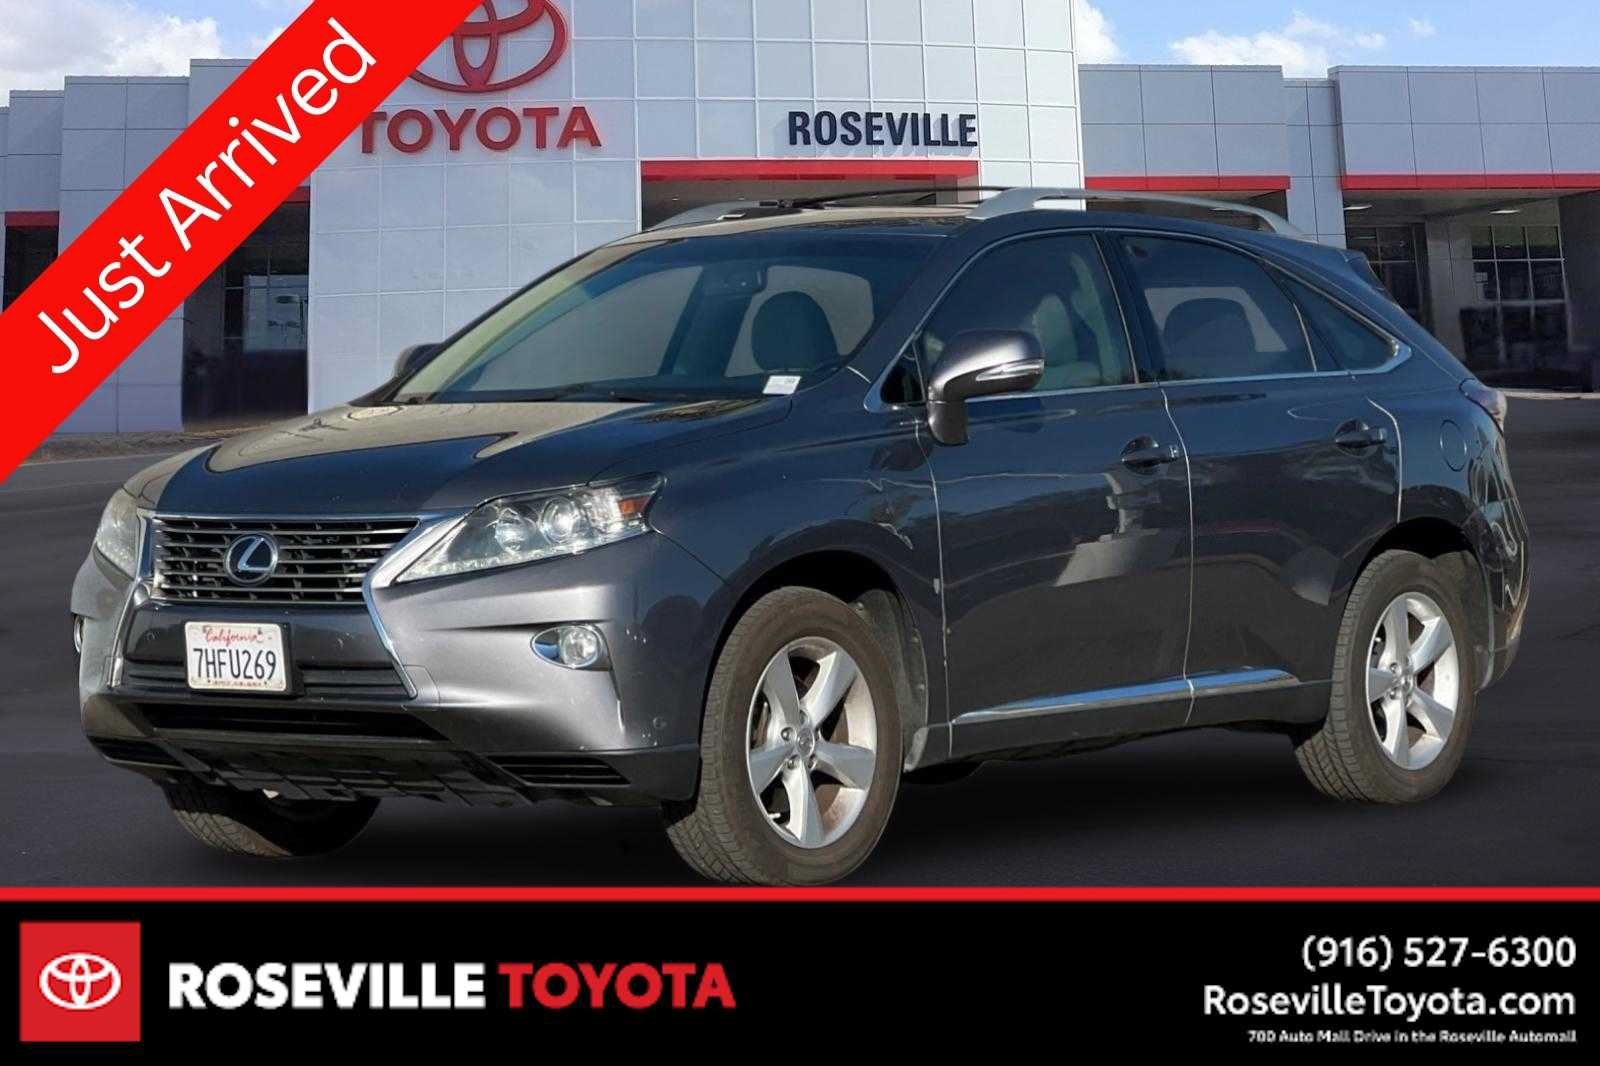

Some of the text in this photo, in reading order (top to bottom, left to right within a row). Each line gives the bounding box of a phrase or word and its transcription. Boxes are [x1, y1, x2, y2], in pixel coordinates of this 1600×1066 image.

[360, 105, 602, 154] TOYOTA
[788, 110, 978, 148] ROSEVILLE
[204, 625, 258, 647] California
[193, 647, 277, 680] 7HFU269
